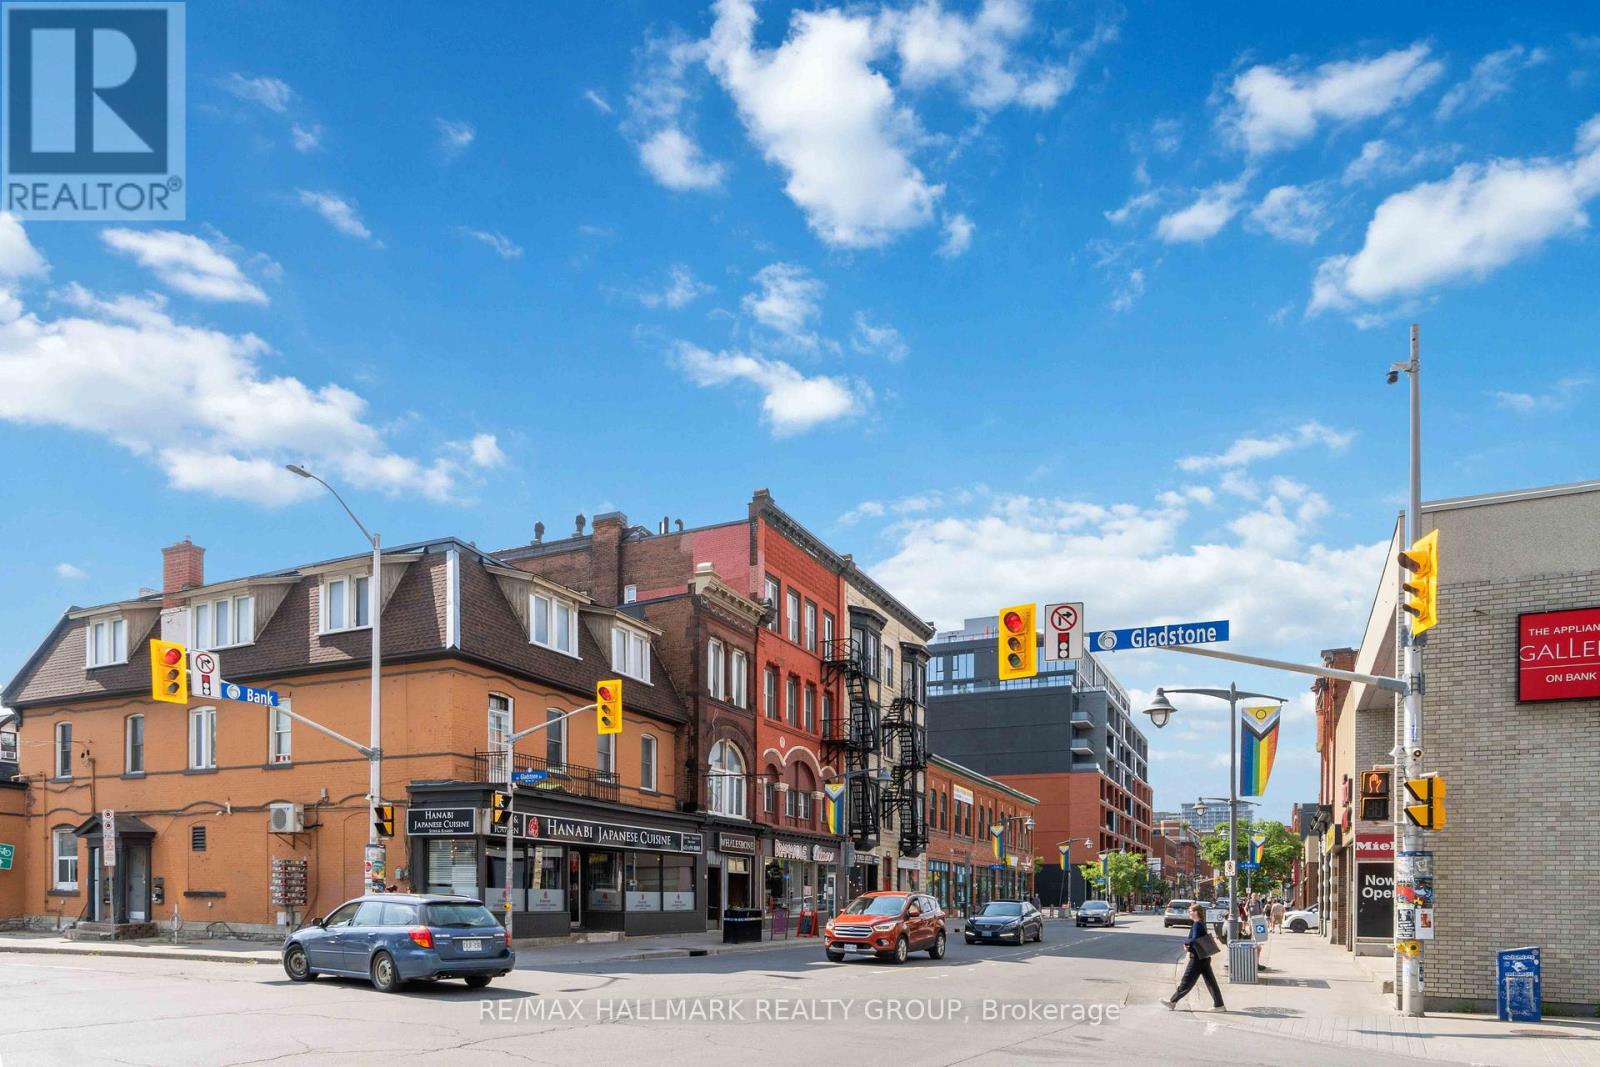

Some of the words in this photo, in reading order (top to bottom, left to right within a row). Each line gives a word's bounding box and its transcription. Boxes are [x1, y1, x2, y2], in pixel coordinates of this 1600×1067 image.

[1131, 626, 1217, 648] Gladstone
[1528, 627, 1550, 637] THE
[1519, 637, 1600, 662] GALLE
[1546, 674, 1563, 683] ON
[1566, 672, 1597, 682] BANK
[247, 688, 274, 706] Bank
[425, 811, 454, 820] HANABI
[414, 820, 442, 830] JAPANESE
[443, 820, 470, 829] CUISINE
[547, 819, 593, 838] HANABI
[598, 826, 638, 843] JAPANESE
[640, 831, 672, 846] CUISINE
